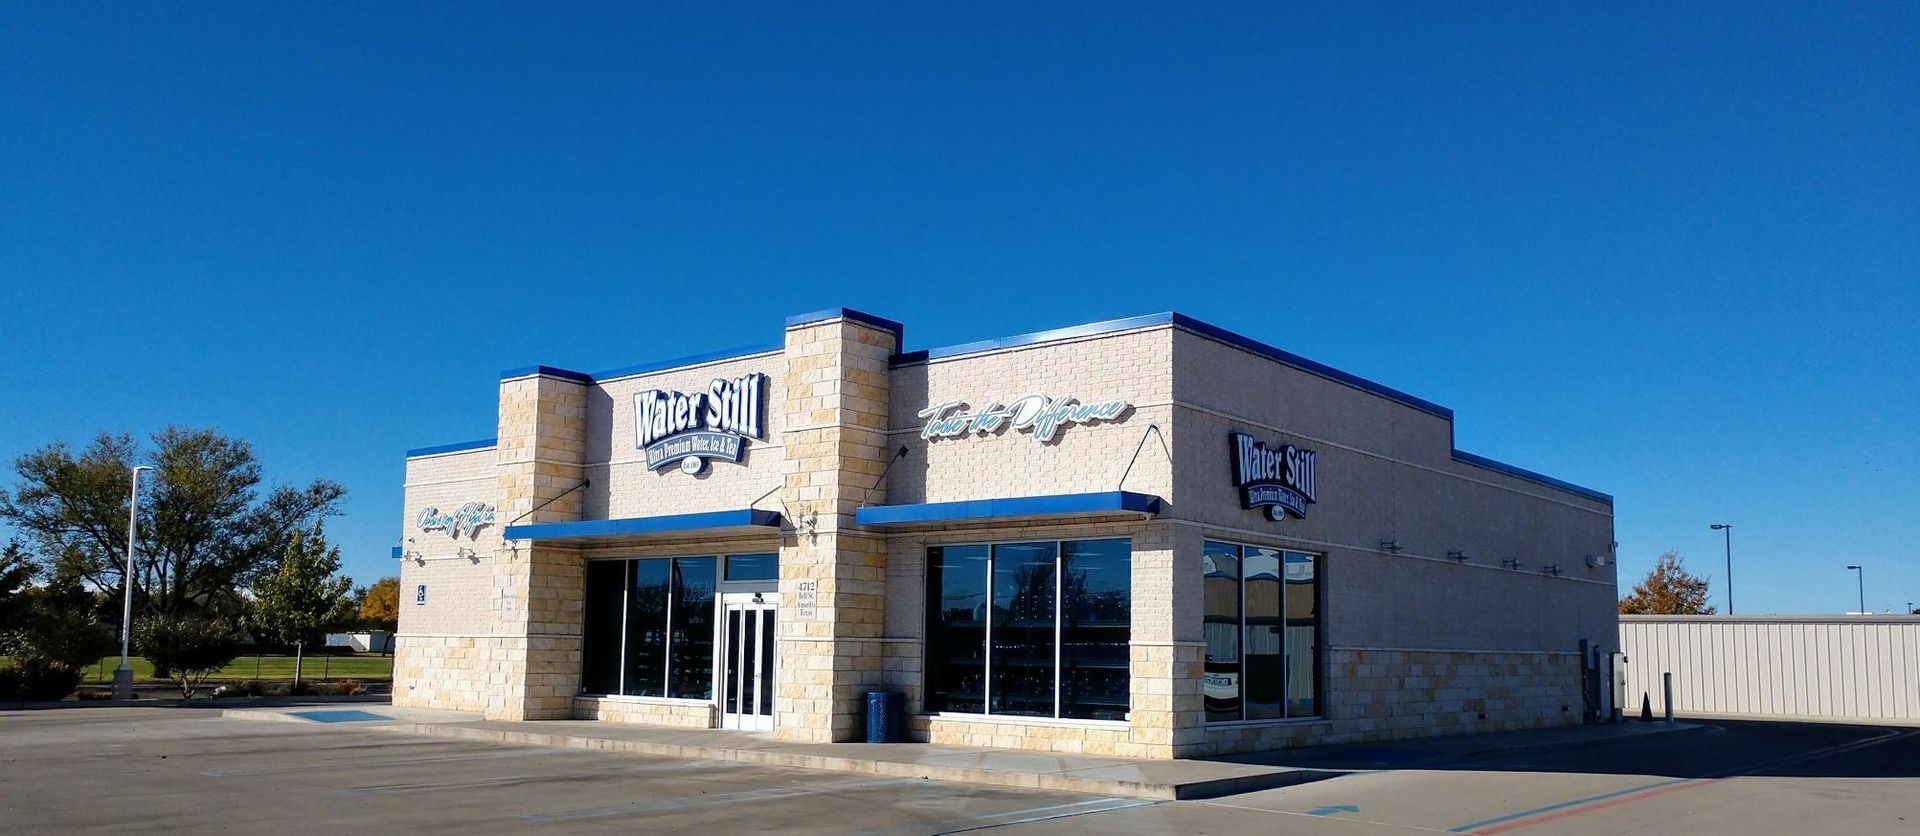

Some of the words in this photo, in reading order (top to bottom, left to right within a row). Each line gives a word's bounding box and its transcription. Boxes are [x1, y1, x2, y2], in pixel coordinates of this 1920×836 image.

[634, 390, 701, 449] Water
[707, 373, 761, 438] Still
[918, 401, 968, 440] Taste
[969, 401, 1003, 433] the
[1003, 392, 1129, 441] Difference
[648, 447, 664, 465] Ultra
[664, 439, 691, 458] Premium
[710, 436, 720, 452] Ice
[720, 438, 727, 452] &
[727, 438, 737, 455] Tea
[1237, 434, 1282, 485] Water
[1286, 445, 1316, 502] Still
[798, 582, 815, 591] 4712
